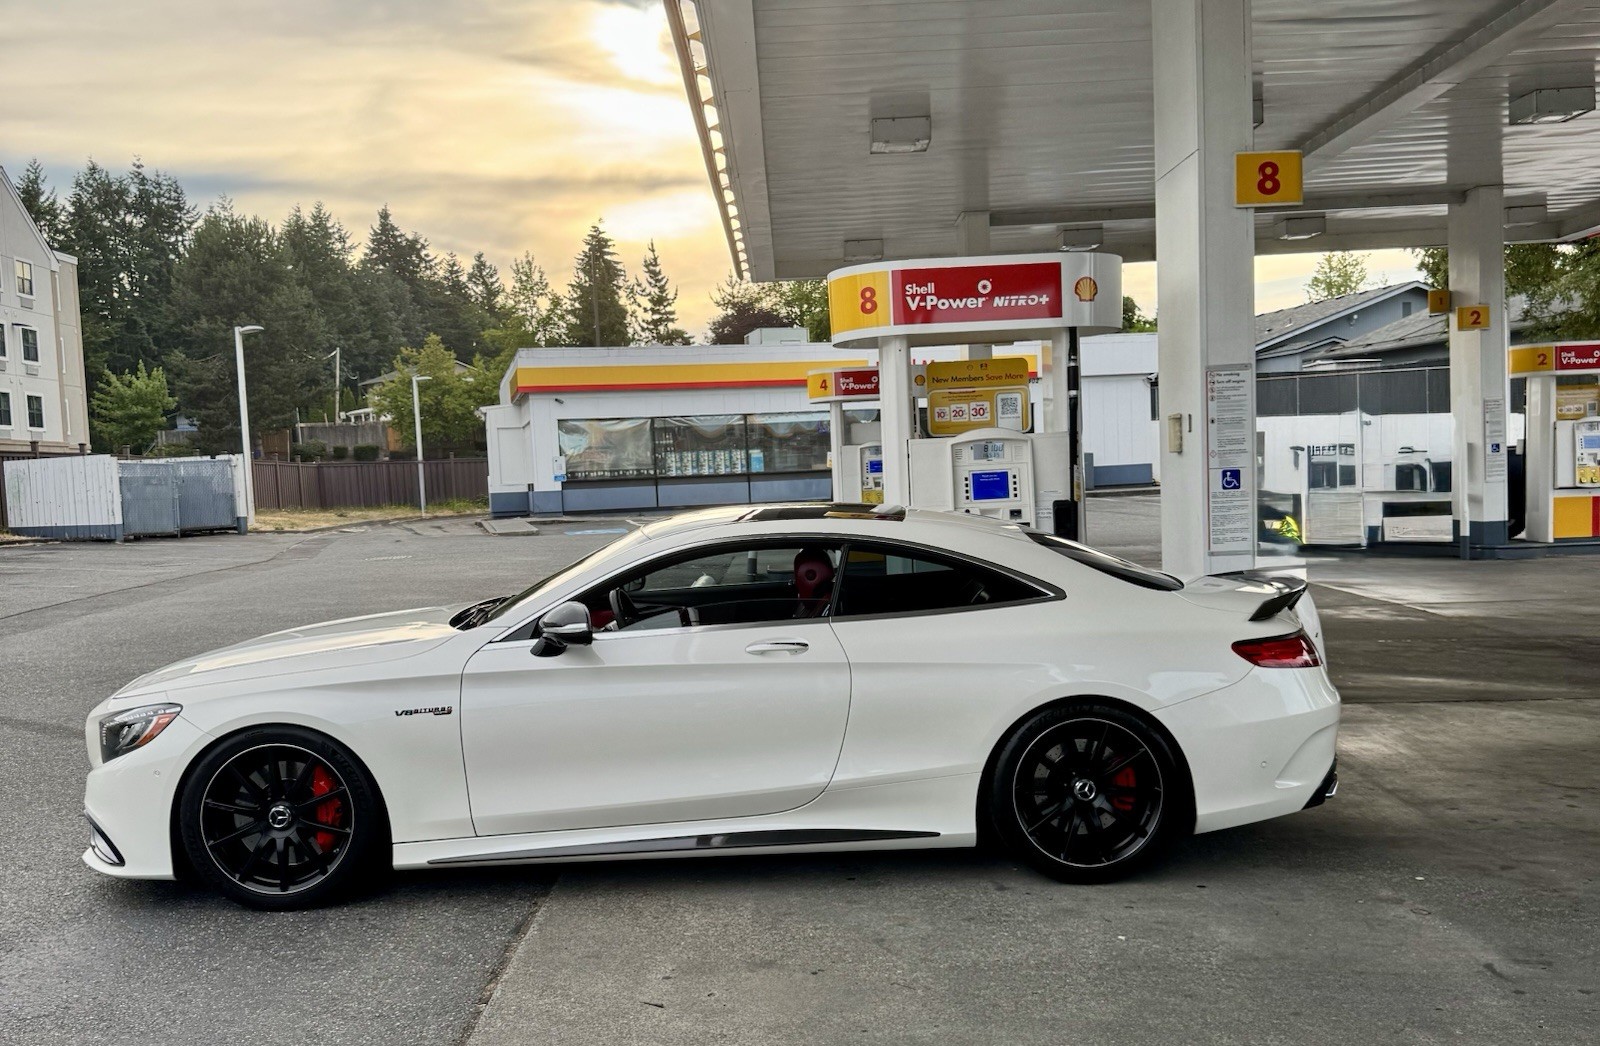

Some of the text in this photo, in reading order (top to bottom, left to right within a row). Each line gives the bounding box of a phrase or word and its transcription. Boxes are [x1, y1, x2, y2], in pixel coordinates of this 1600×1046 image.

[1257, 161, 1281, 195] 8
[905, 282, 935, 295] Shell
[860, 286, 877, 314] 8
[906, 295, 985, 311] V-Power
[1439, 297, 1443, 305] 1
[1470, 310, 1481, 325] 2
[1537, 353, 1547, 366] 2
[951, 374, 984, 382] Members
[819, 379, 828, 391] 4
